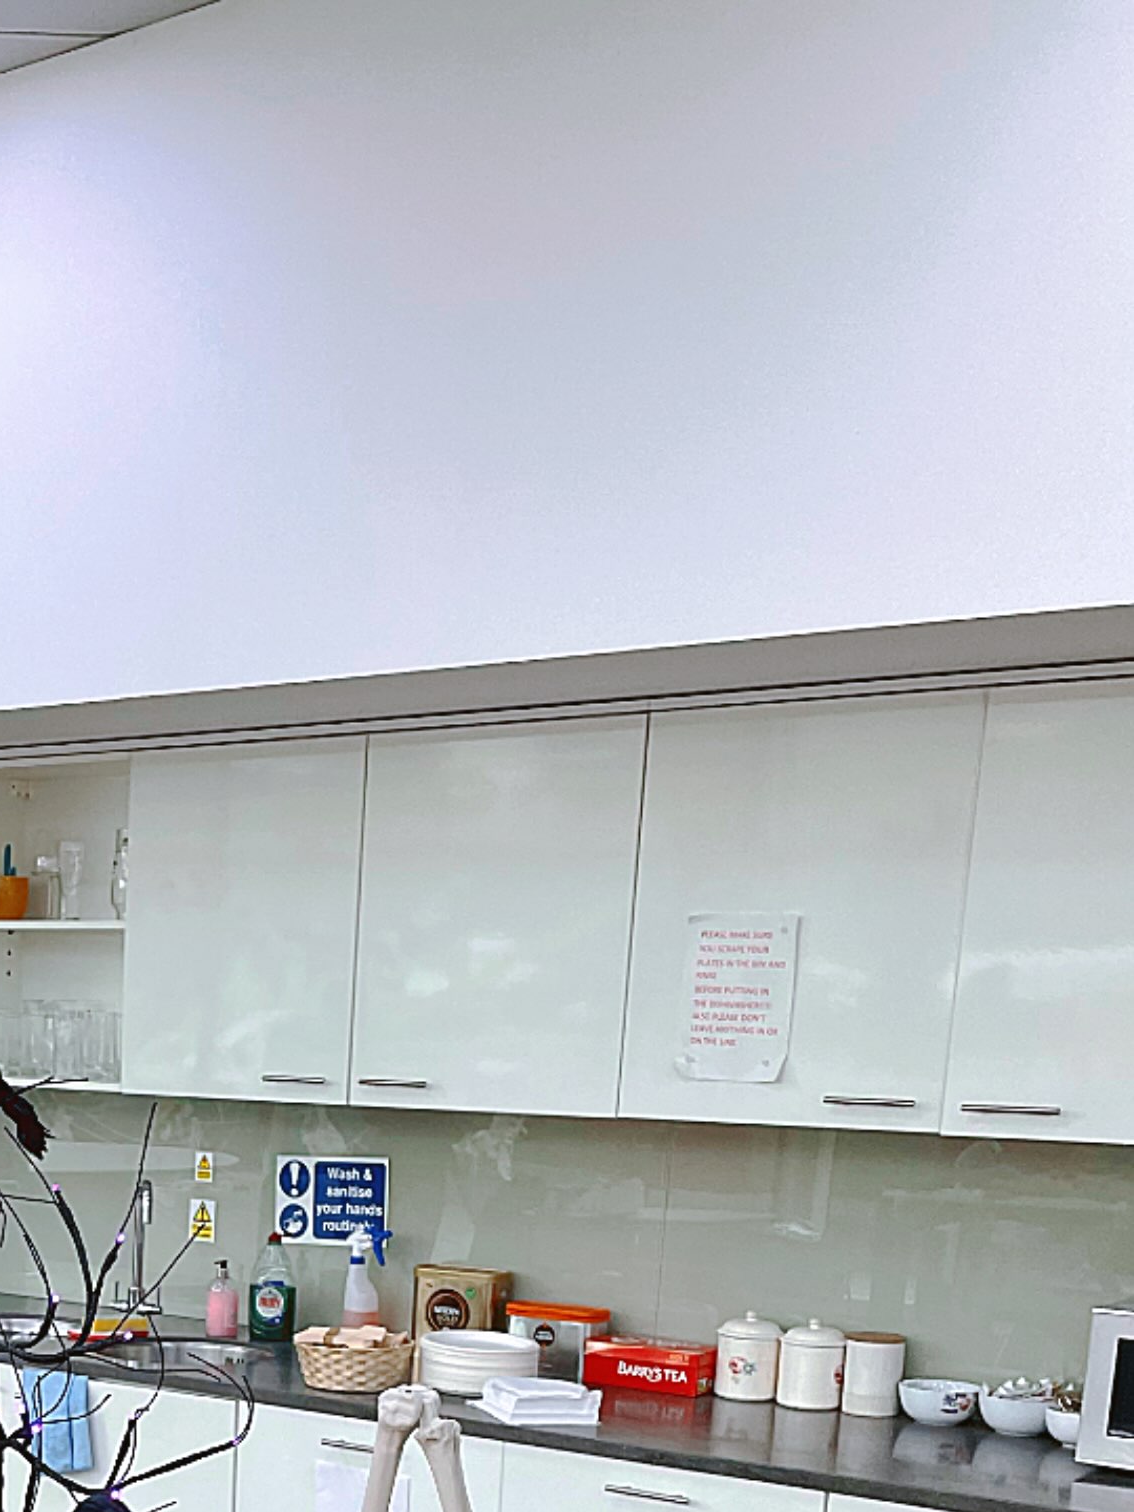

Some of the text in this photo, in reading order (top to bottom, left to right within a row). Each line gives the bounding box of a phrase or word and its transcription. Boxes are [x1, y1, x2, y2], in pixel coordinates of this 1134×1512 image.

[327, 1167, 373, 1181] Wash &
[327, 1185, 373, 1198] sanitise
[316, 1203, 383, 1216] your hands
[663, 1368, 687, 1383] TEA
